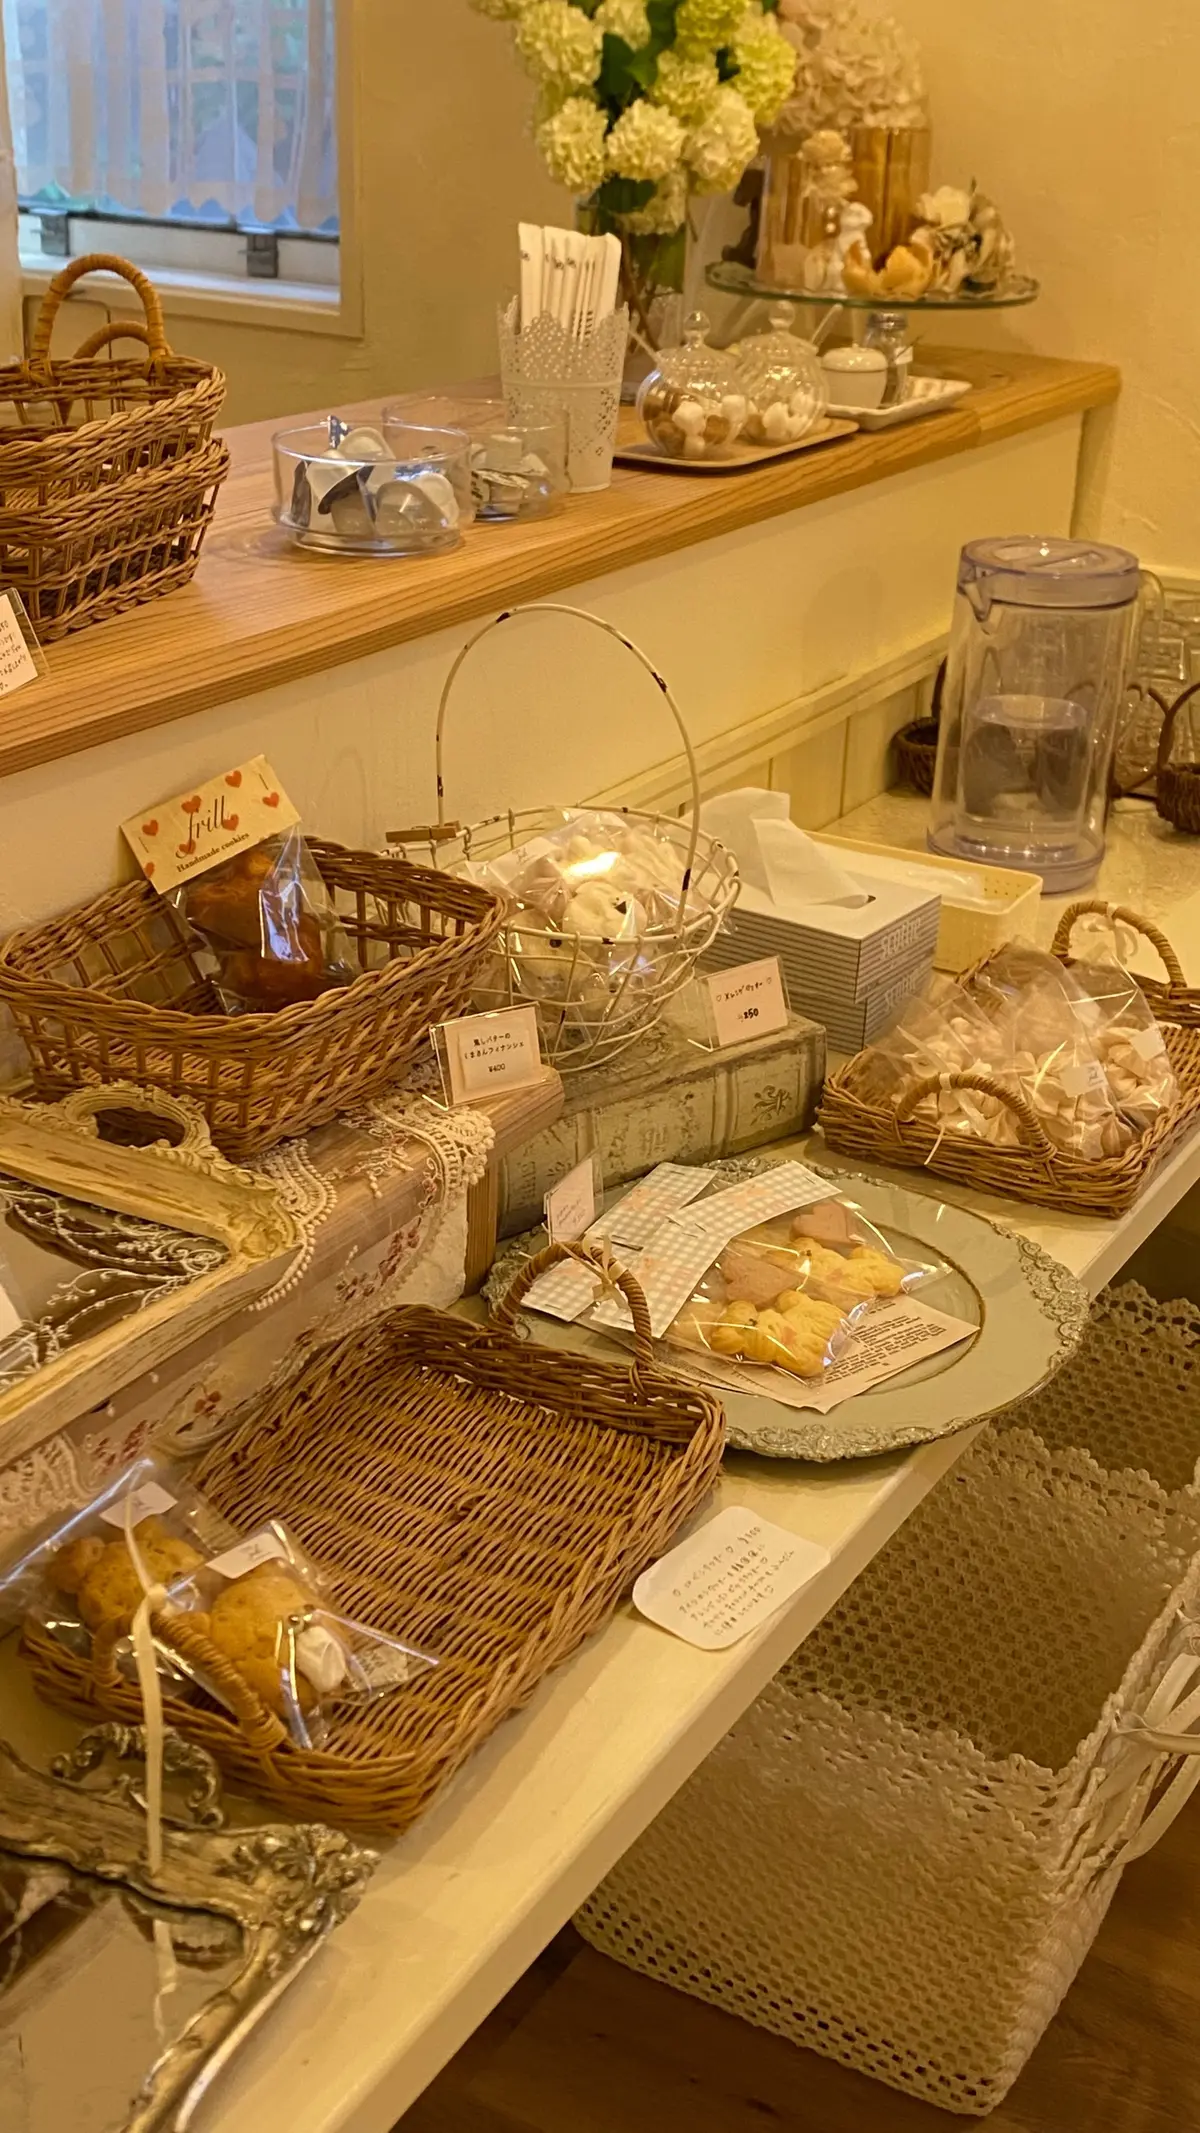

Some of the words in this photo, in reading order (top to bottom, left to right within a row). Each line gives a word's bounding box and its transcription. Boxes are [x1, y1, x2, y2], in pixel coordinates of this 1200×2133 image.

[175, 795, 227, 859] frill
[176, 847, 221, 873] Handmade
[221, 832, 250, 851] cookies
[488, 1063, 506, 1073] ¥400
